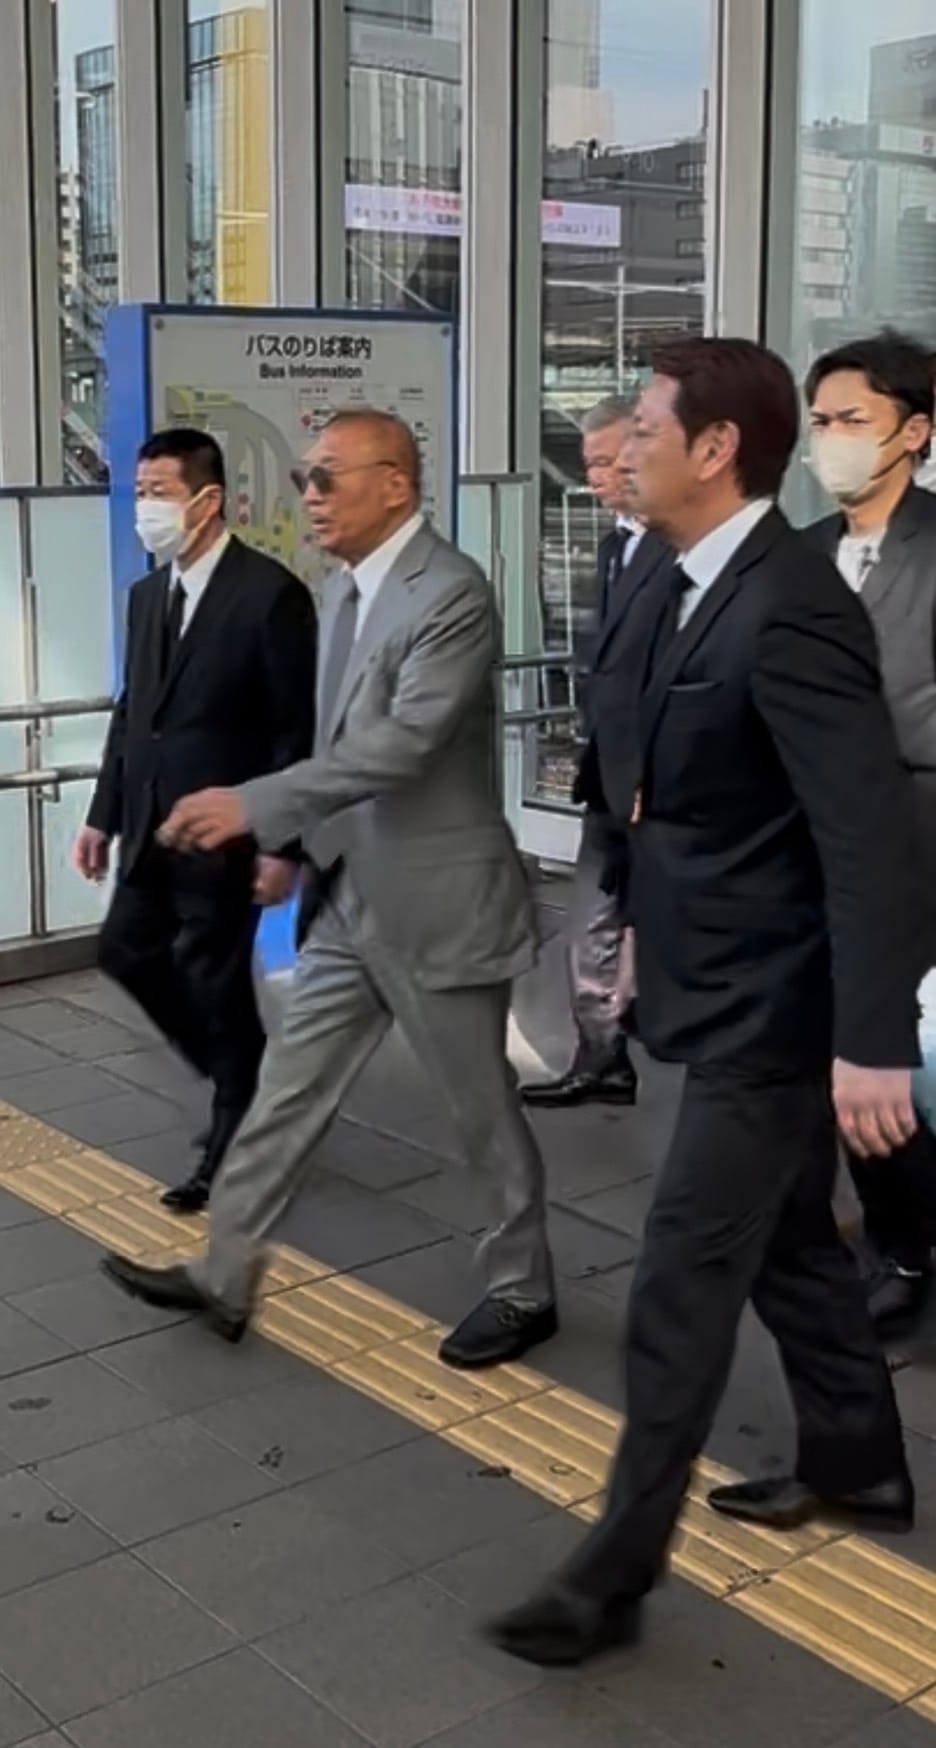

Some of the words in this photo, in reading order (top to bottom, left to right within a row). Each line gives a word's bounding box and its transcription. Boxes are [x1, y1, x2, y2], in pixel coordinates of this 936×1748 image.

[246, 335, 371, 359] バスのりば案内
[260, 363, 285, 378] Bus
[290, 364, 362, 378] Information
